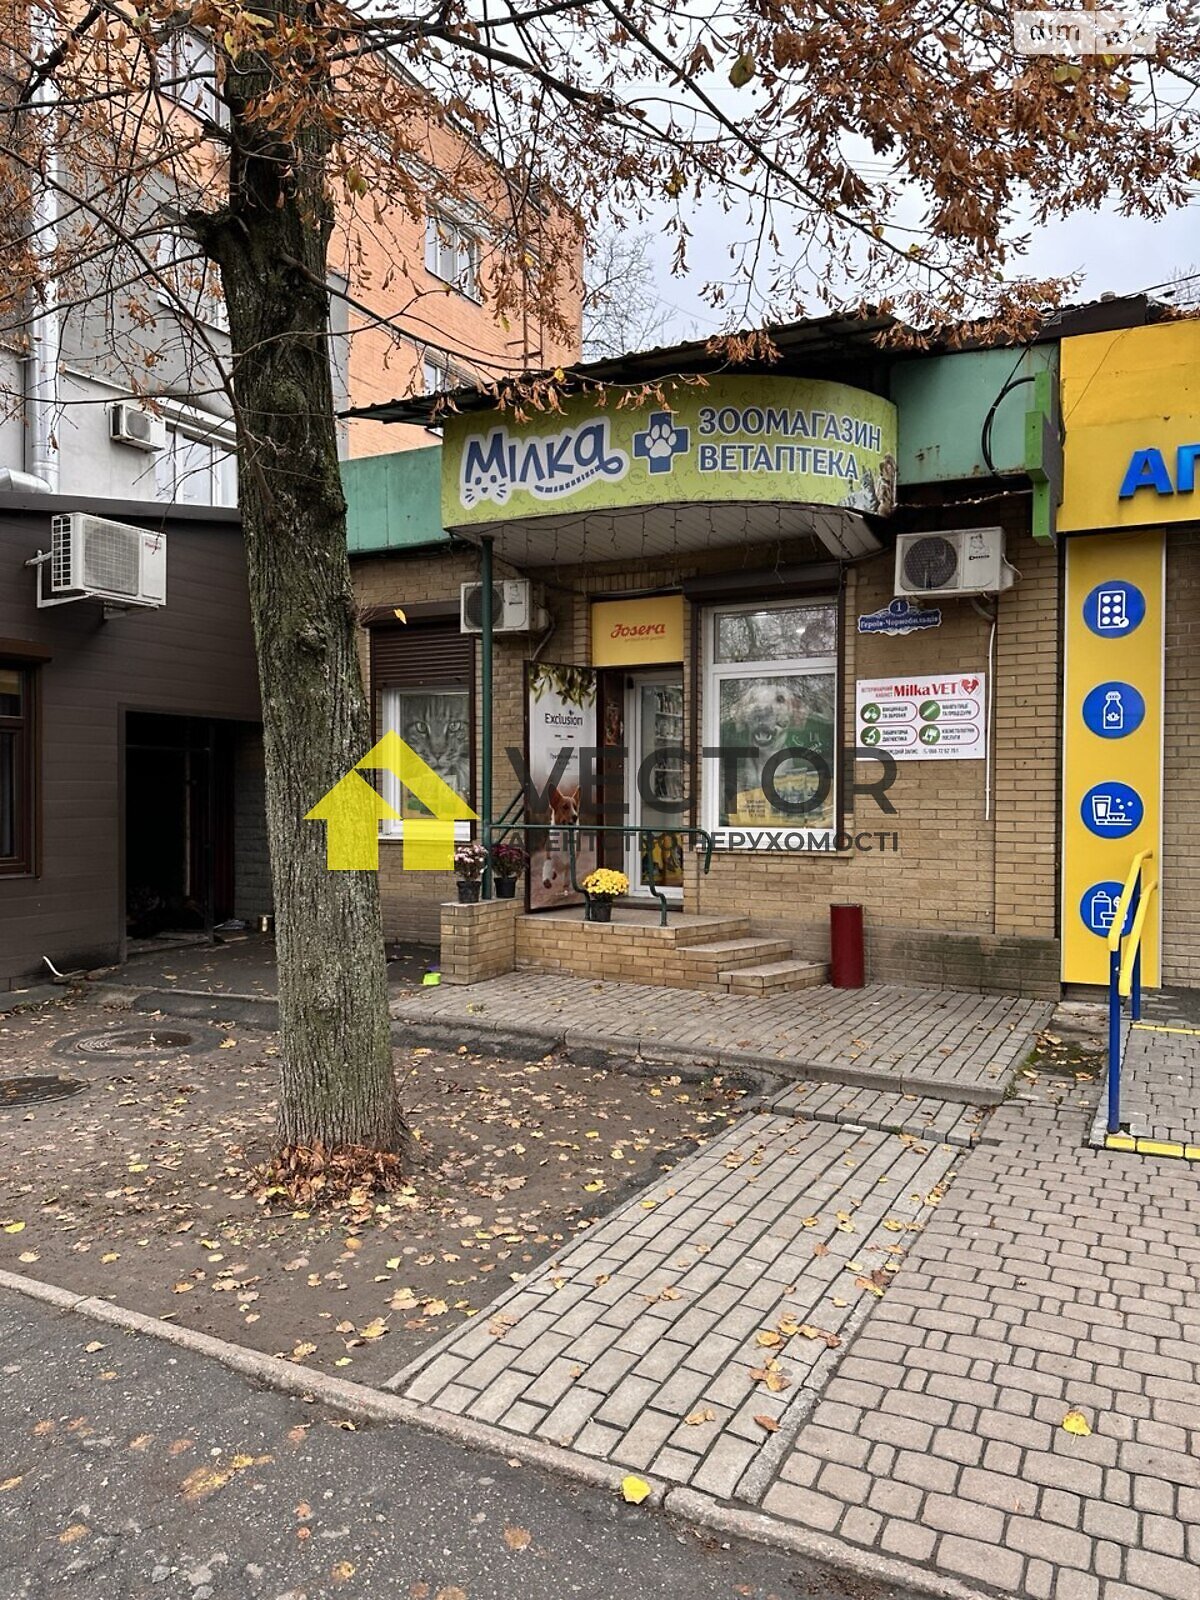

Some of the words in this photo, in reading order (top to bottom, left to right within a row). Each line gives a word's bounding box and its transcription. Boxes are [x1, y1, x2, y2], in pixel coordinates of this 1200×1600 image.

[699, 406, 883, 454] ЗООМАГАЗИН
[699, 442, 860, 481] ВЕТАПТЕКА
[610, 623, 666, 639] Josera
[544, 713, 583, 726] Exclusion
